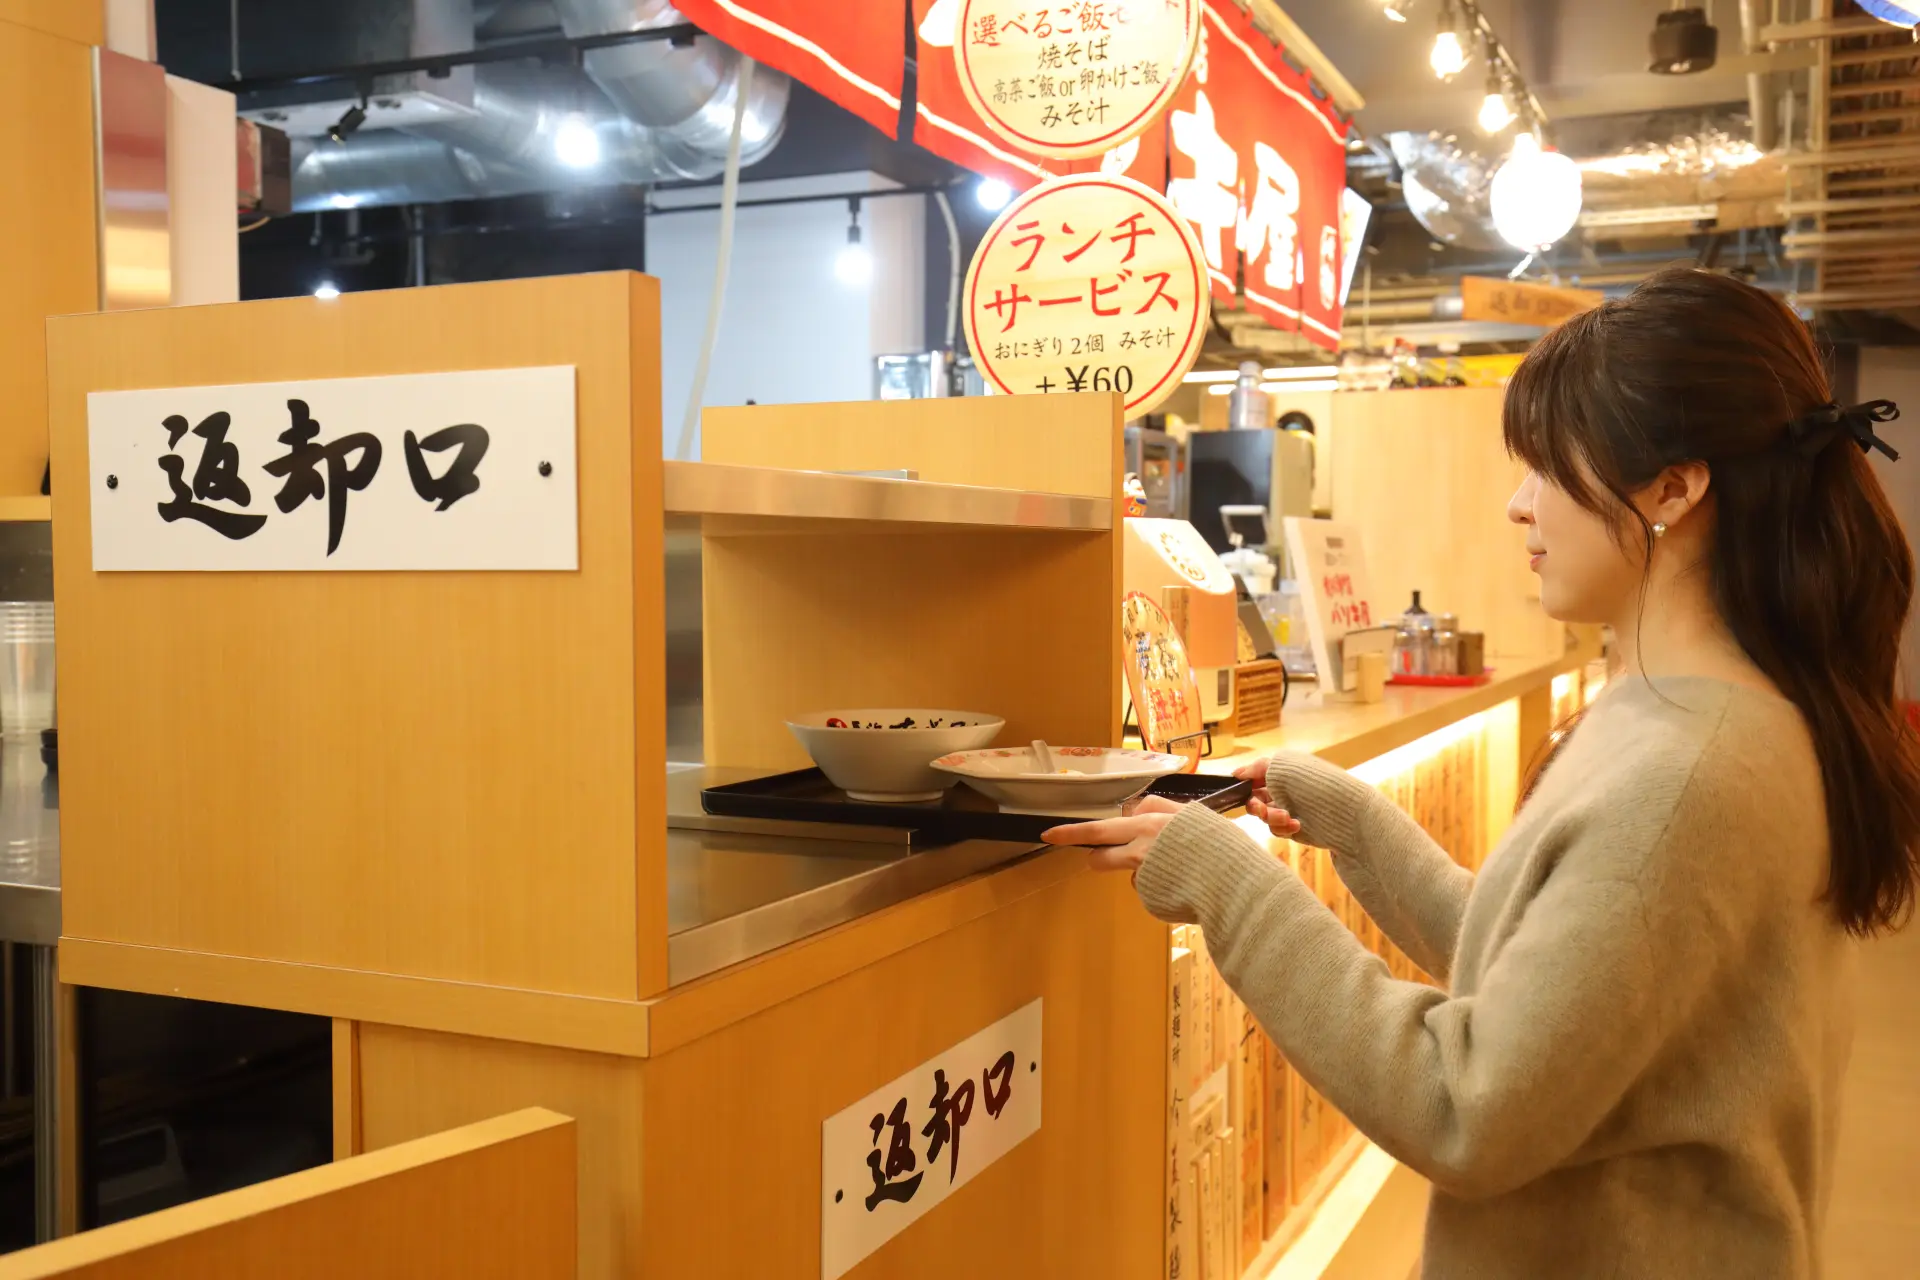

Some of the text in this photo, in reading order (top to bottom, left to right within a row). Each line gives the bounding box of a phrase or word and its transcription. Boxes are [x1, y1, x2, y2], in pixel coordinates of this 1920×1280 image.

[1038, 34, 1111, 69] 焼そば
[1040, 97, 1110, 128] みそ汁
[1010, 211, 1156, 272] ランチ
[983, 268, 1179, 333] サービス
[1119, 326, 1176, 350] みそ汁
[157, 398, 490, 558] 返却口
[864, 1050, 1015, 1212] 返却口
